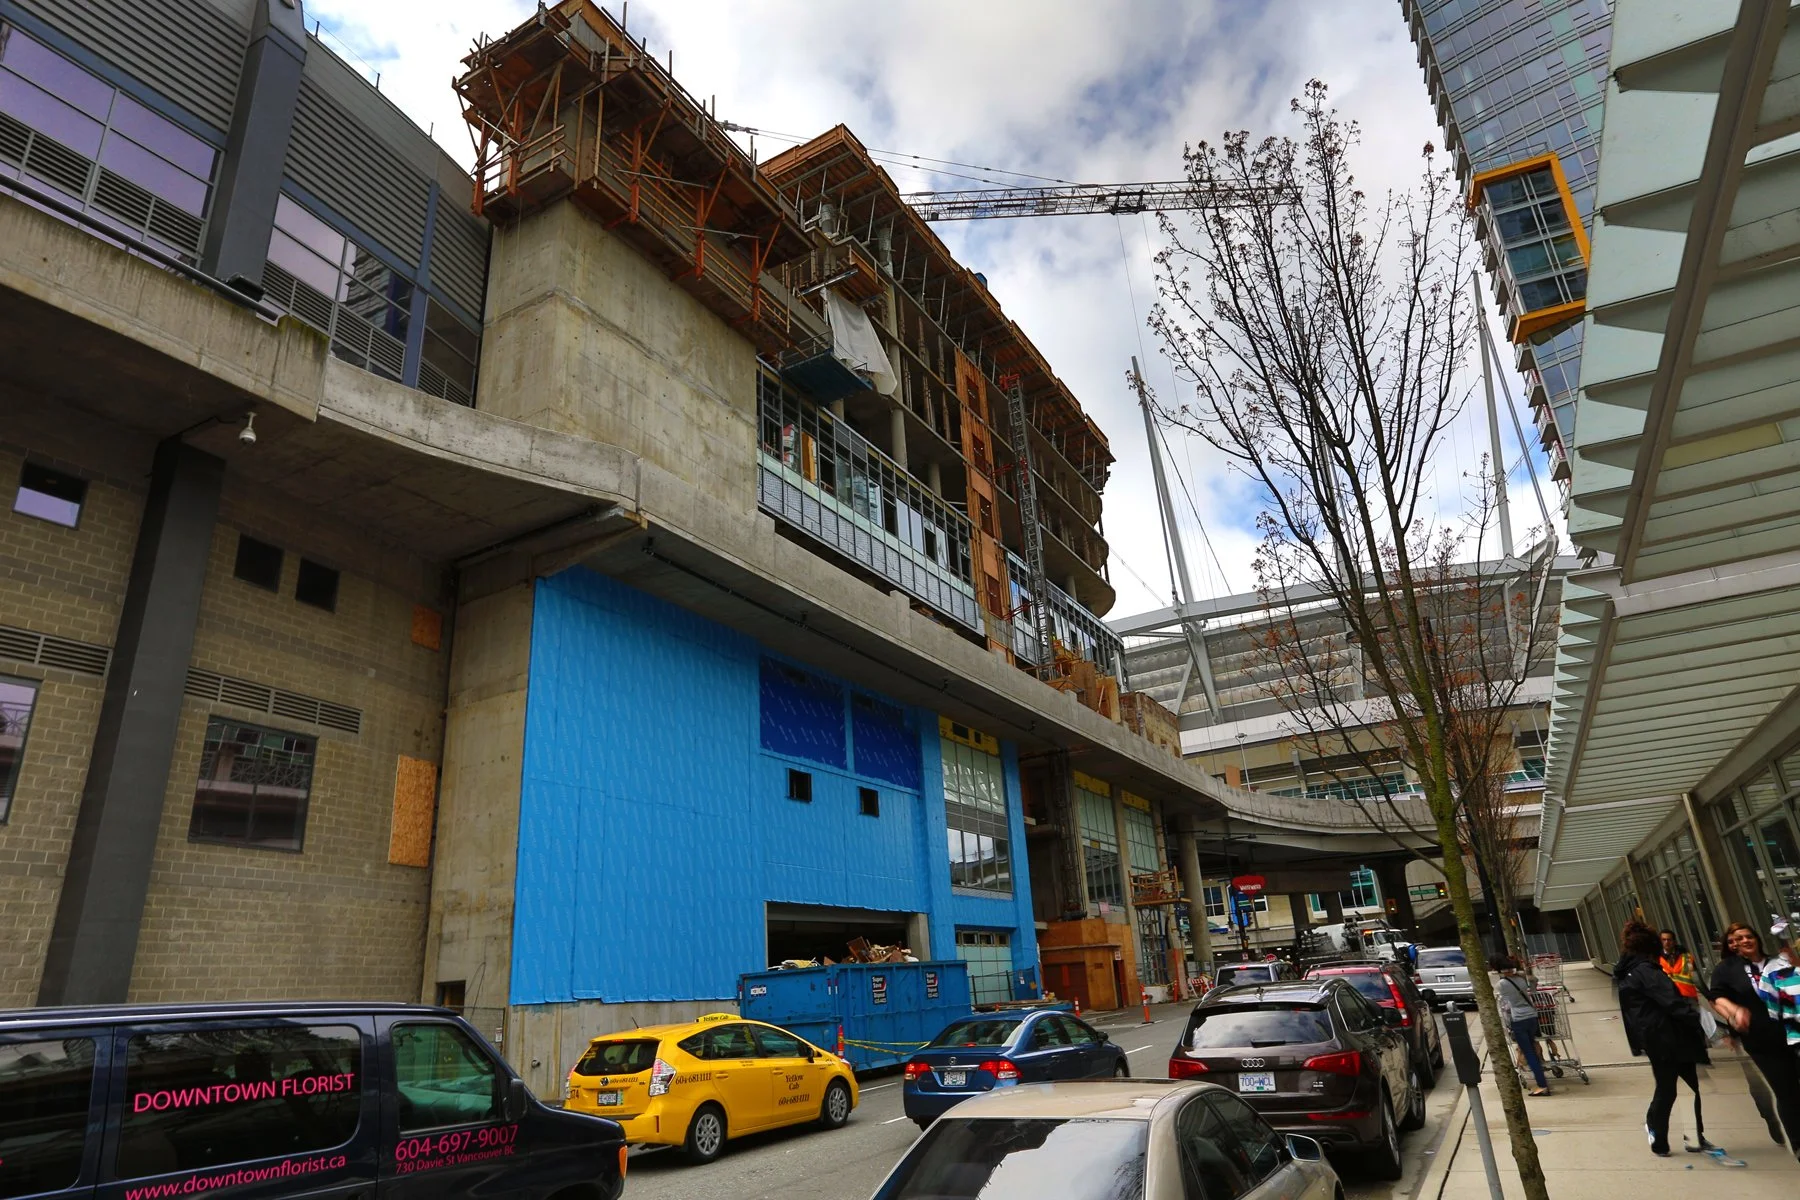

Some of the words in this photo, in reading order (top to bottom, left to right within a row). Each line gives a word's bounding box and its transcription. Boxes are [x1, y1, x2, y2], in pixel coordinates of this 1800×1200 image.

[134, 1081, 276, 1112] DOWNTOWN
[282, 1074, 354, 1096] FLORIST
[785, 1074, 804, 1083] Yellow
[788, 1081, 800, 1091] Cab
[395, 1124, 518, 1160] 604-697-9007
[396, 1162, 414, 1175] 730
[416, 1158, 444, 1171] Davie
[446, 1154, 455, 1166] St
[457, 1149, 502, 1164] Vancouver
[504, 1145, 515, 1155] BC
[125, 1155, 346, 1200] www.downtownflorist.ca
